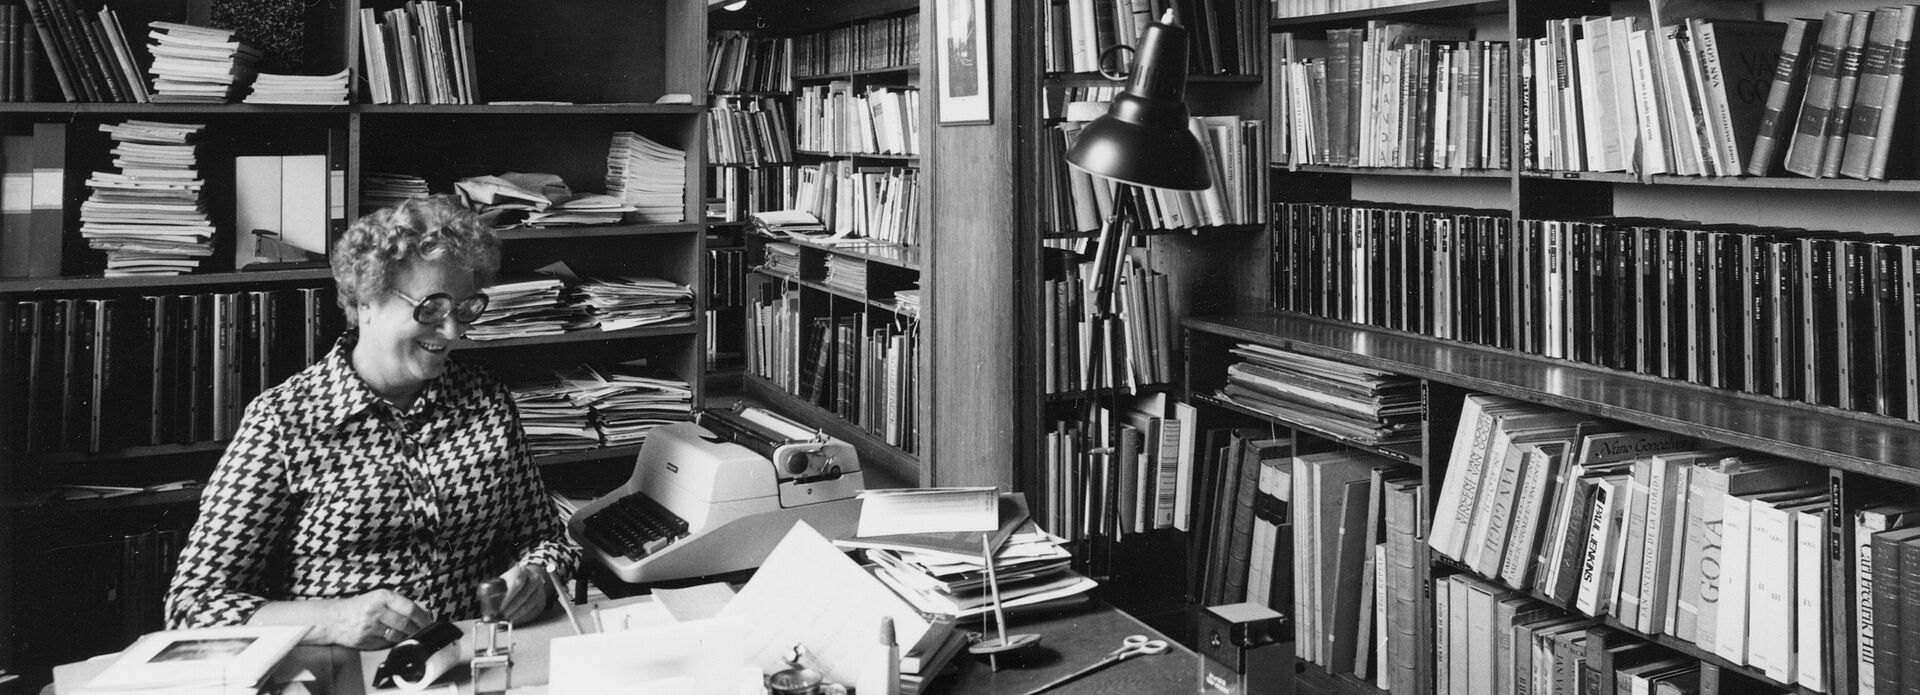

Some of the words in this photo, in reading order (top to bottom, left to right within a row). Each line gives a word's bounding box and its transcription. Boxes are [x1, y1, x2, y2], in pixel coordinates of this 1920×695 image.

[1704, 32, 1717, 64] GOGH
[1736, 52, 1776, 77] VA
[1710, 67, 1721, 88] VAN
[1459, 483, 1479, 525] VINCENT
[1471, 455, 1483, 476] VAN
[1479, 411, 1494, 451] GOGH
[1499, 466, 1515, 497] VAN
[1454, 478, 1473, 522] VINCENT
[1467, 452, 1478, 473] VAN
[1651, 474, 1660, 515] FLORIDA
[1486, 502, 1507, 554] GOGH
[1591, 503, 1604, 536] PAUL
[1649, 517, 1656, 531] LA
[1649, 532, 1655, 546] DE
[1584, 535, 1599, 583] JENKINS
[1642, 545, 1653, 595] ANTONIO
[1701, 519, 1723, 604] GOYA
[1860, 543, 1872, 574] Carl
[1861, 577, 1873, 632] Fredrik
[1862, 633, 1874, 665] Hill
